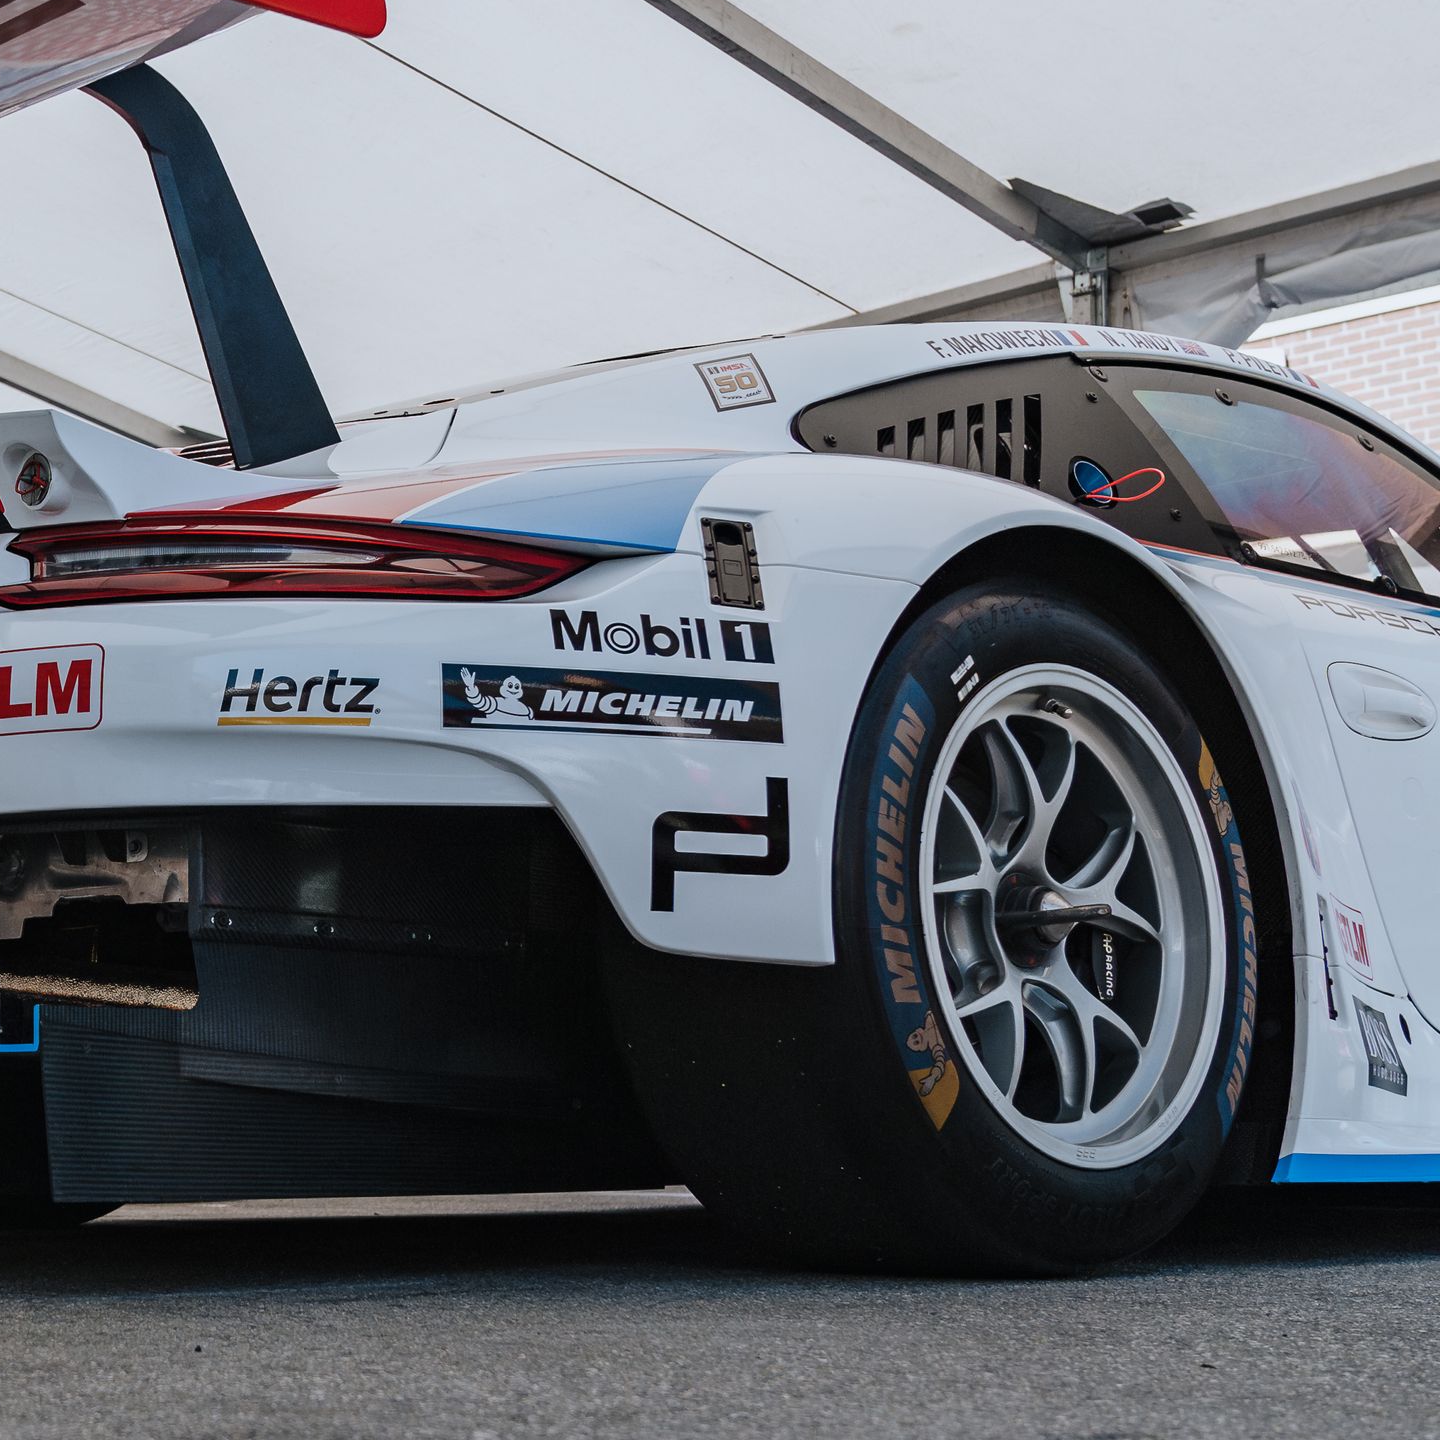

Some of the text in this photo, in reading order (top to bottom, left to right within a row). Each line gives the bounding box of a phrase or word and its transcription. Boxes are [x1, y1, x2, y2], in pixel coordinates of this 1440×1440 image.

[714, 371, 758, 393] 50
[550, 609, 711, 660] Mobil
[540, 689, 754, 722] MICHELIN
[876, 702, 927, 1004] MICHELIN
[1105, 954, 1115, 997] RACING
[1228, 842, 1258, 1115] MICHELIN
[1360, 1011, 1398, 1066] BOSS
